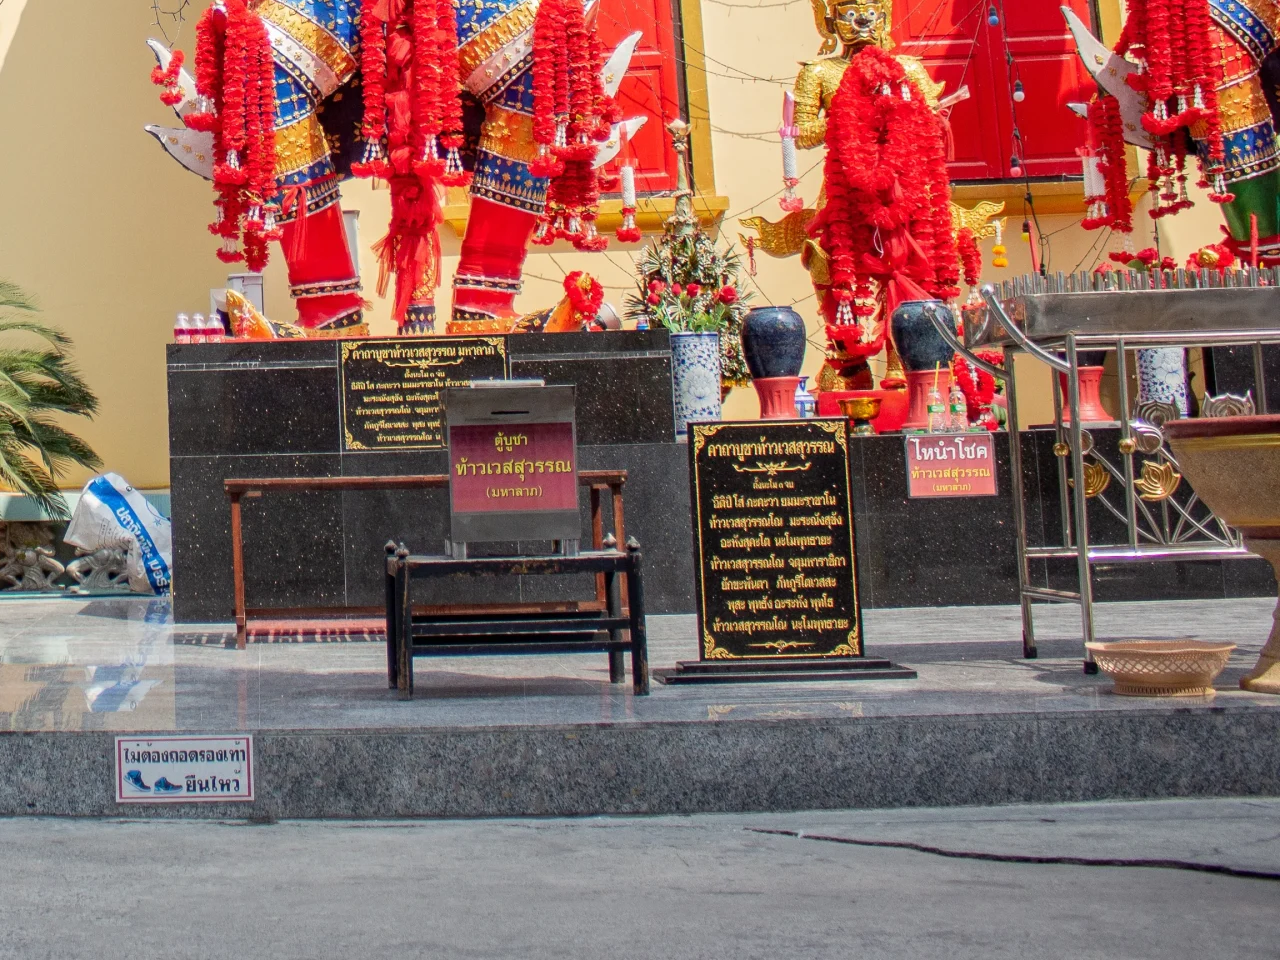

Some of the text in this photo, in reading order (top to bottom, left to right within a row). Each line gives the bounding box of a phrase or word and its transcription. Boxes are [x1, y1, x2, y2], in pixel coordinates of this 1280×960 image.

[352, 344, 495, 363] คาถาบูชาท้าวเวสสุวรรณ มหาลาภ
[494, 431, 528, 453] ตู้บูชา
[707, 436, 836, 462] คาถาบูชาท้าวเวสสุวรรณ
[910, 437, 988, 461] ไหนำโชค
[455, 457, 572, 482] ท้าวเวสสุวรรณ
[911, 466, 991, 483] ท้าวเวสสุวรรณ
[486, 485, 543, 499] (มหาลาภ)
[932, 483, 972, 493] (มหาลาภ)
[774, 532, 832, 551] นะโมพุทธายะ
[791, 614, 849, 634] นะโมพุทธายะ
[123, 740, 247, 764] ไม่ต้องถอดรองเท้า
[184, 769, 241, 793] ยืนไหว้
